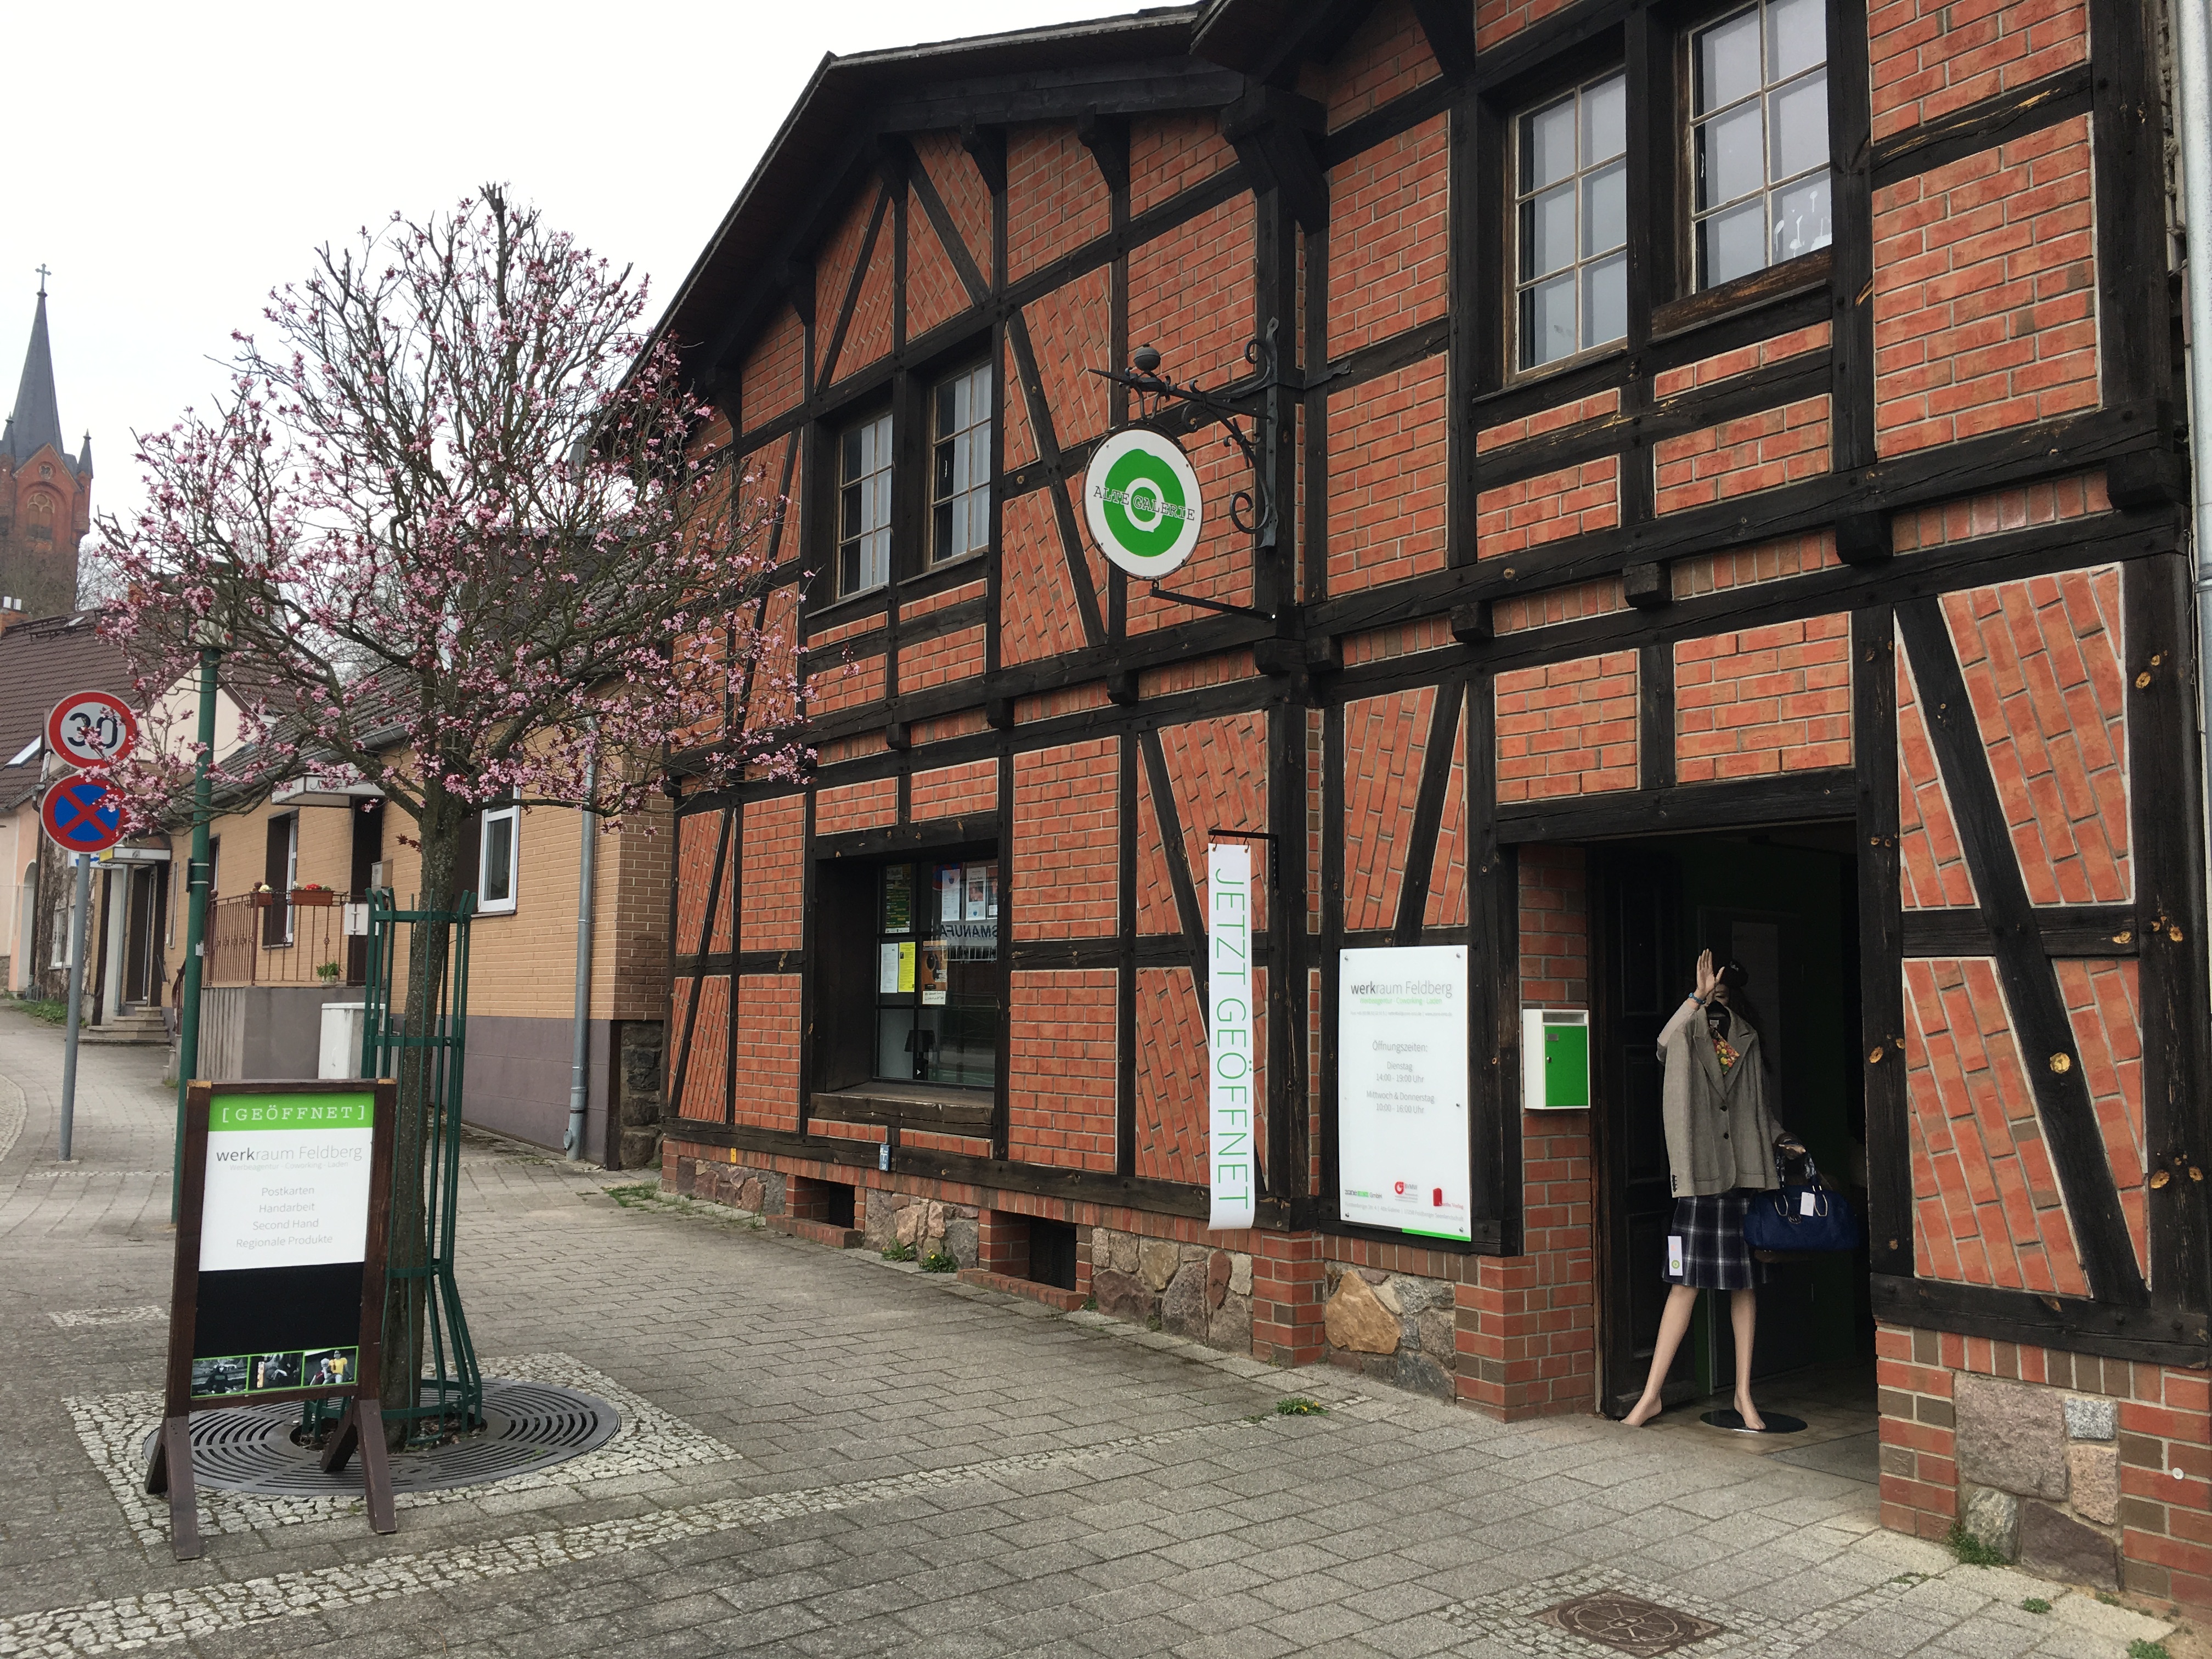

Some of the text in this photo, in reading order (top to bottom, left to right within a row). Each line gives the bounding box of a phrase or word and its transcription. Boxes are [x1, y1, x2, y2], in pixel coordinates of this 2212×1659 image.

[1093, 486, 1195, 521] ALTE GALERIE
[67, 712, 118, 749] 30
[1351, 980, 1452, 998] werkraum Feldberg
[1215, 868, 1252, 1210] JETZT GEÖFFNET
[1372, 1040, 1428, 1053] Öffnungszeiten:
[1387, 1061, 1413, 1072] Dienstag
[1376, 1074, 1391, 1082] 14:00
[1396, 1074, 1412, 1082] 19:00
[1413, 1075, 1424, 1083] Uhr
[1366, 1090, 1435, 1104] Mittwoch & Donnerstag
[1376, 1103, 1391, 1111] 10:00
[1396, 1104, 1412, 1113] 16:00
[1413, 1105, 1425, 1113] Uhr
[217, 1146, 362, 1161] werkraum Feldberg
[261, 1187, 314, 1197] Postkarten
[259, 1203, 315, 1213] Handarbeit
[252, 1218, 319, 1231] Second Hand
[236, 1234, 333, 1250] Regionale Produkte
